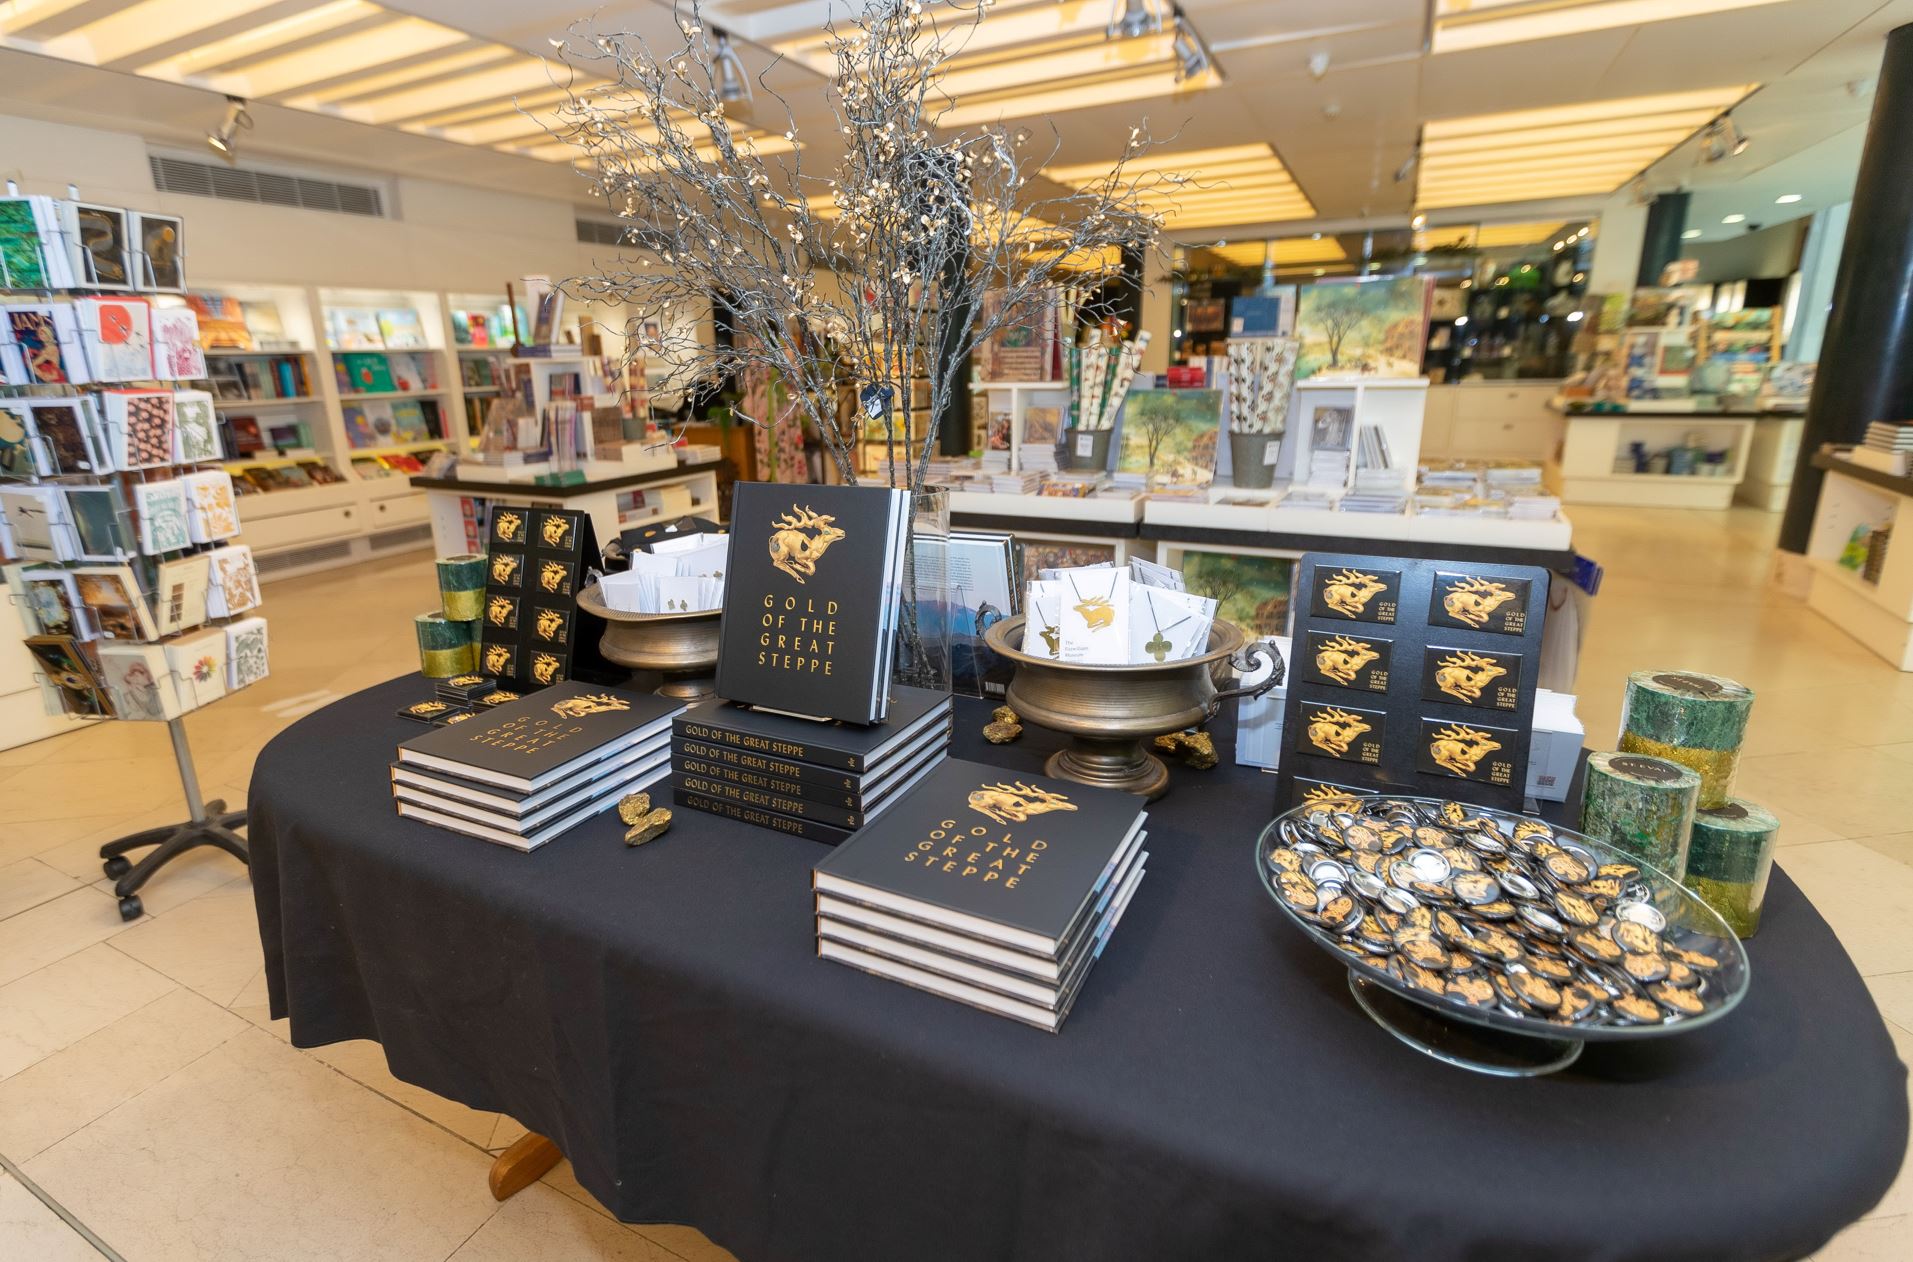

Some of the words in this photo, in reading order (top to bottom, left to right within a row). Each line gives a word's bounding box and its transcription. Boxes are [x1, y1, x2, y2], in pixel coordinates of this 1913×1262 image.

[764, 594, 838, 615] GOLD
[762, 613, 785, 628] OF
[800, 618, 836, 635] THE
[760, 633, 834, 655] GREAT
[758, 651, 832, 675] STEPPE
[487, 728, 556, 747] GREAT
[502, 722, 527, 731] OF
[534, 728, 570, 740] THE
[518, 716, 582, 733] GOLD
[686, 724, 708, 736] GOLD
[712, 730, 722, 740] OF
[725, 732, 740, 744] THE
[744, 736, 769, 750] GREAT
[772, 742, 804, 756] STEPPE
[470, 735, 540, 754] STEPPE
[684, 743, 706, 756] GOLD
[709, 748, 720, 758] OF
[723, 752, 738, 762] THE
[741, 756, 766, 769] GREAT
[770, 762, 800, 776] STEPPE
[684, 760, 707, 772] GOLD
[710, 766, 720, 776] OF
[724, 769, 738, 780] THE
[742, 774, 768, 787] GREAT
[770, 780, 800, 794] STEPPE
[684, 778, 708, 790] GOLD
[710, 784, 722, 794] OF
[725, 786, 740, 798] THE
[743, 792, 770, 805] GREAT
[772, 798, 803, 814] STEPPE
[687, 796, 709, 808] GOLD
[712, 802, 723, 812] OF
[726, 806, 740, 817] THE
[744, 810, 770, 824] GREAT
[772, 818, 803, 834] STEPPE
[930, 830, 965, 844] OF
[985, 841, 1039, 863] THE
[940, 819, 1048, 850] GOLD
[904, 851, 1020, 889] STEPPE
[918, 841, 1031, 875] GREAT
